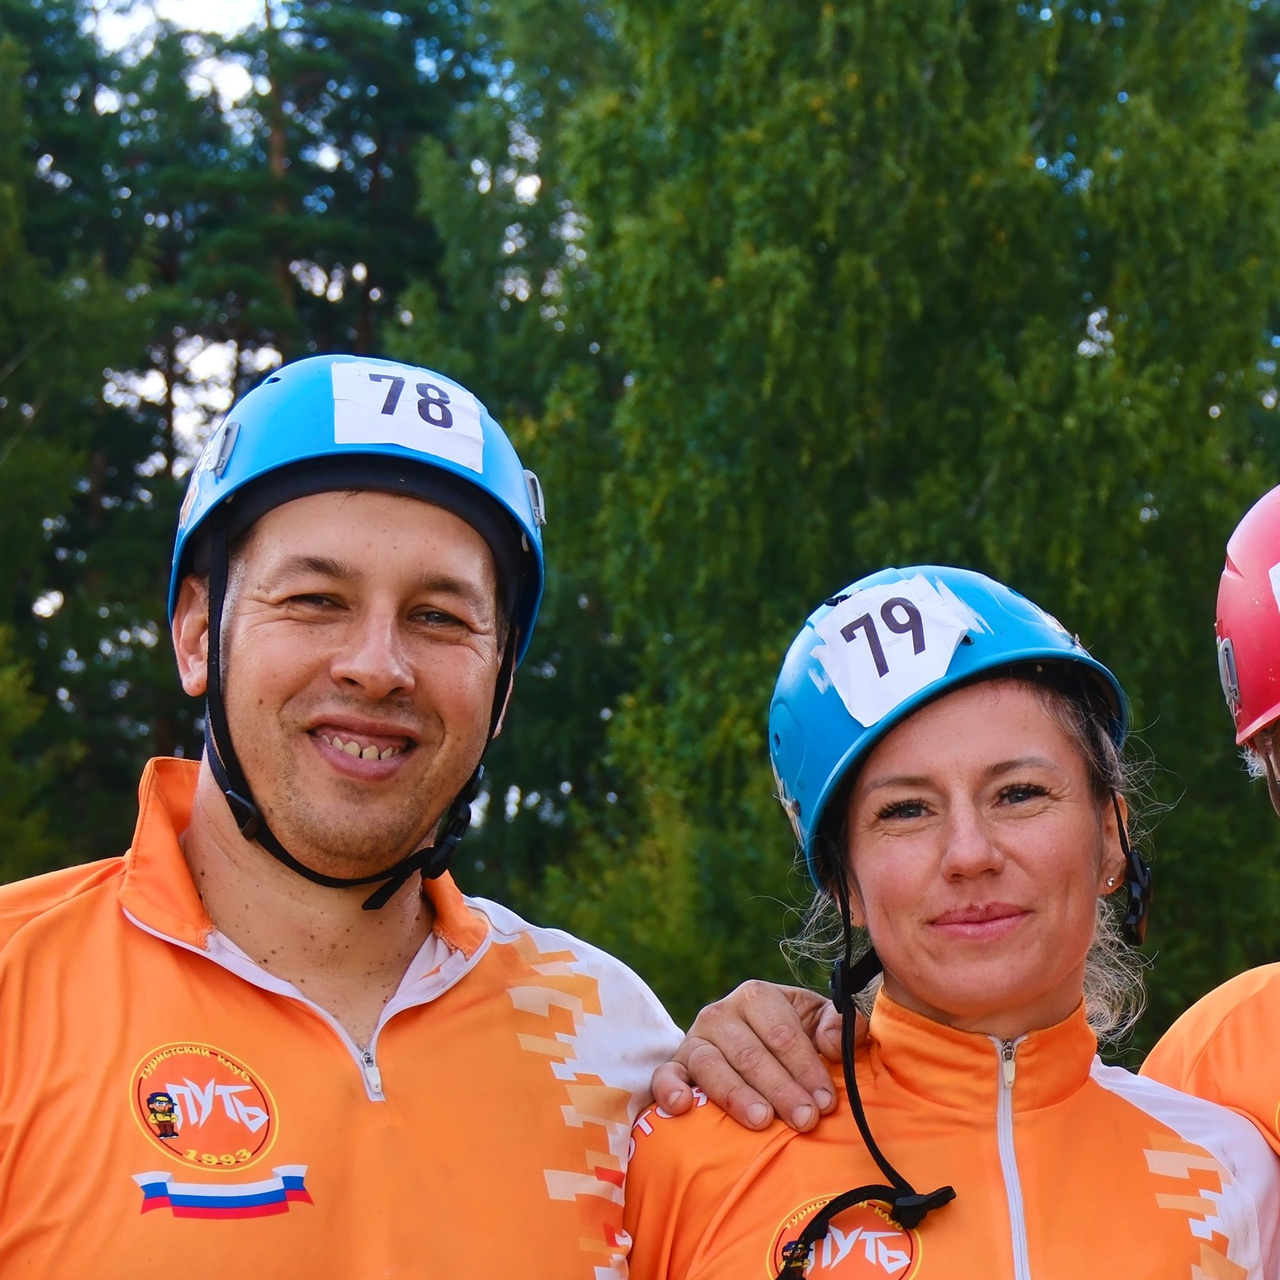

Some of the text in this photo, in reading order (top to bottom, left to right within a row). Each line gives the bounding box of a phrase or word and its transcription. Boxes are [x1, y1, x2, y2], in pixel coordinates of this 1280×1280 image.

[368, 373, 453, 429] 78
[840, 597, 926, 678] 79
[140, 1045, 251, 1082] туристский клуб
[165, 1077, 269, 1134] ПУТЬ
[183, 1148, 252, 1166] 1993
